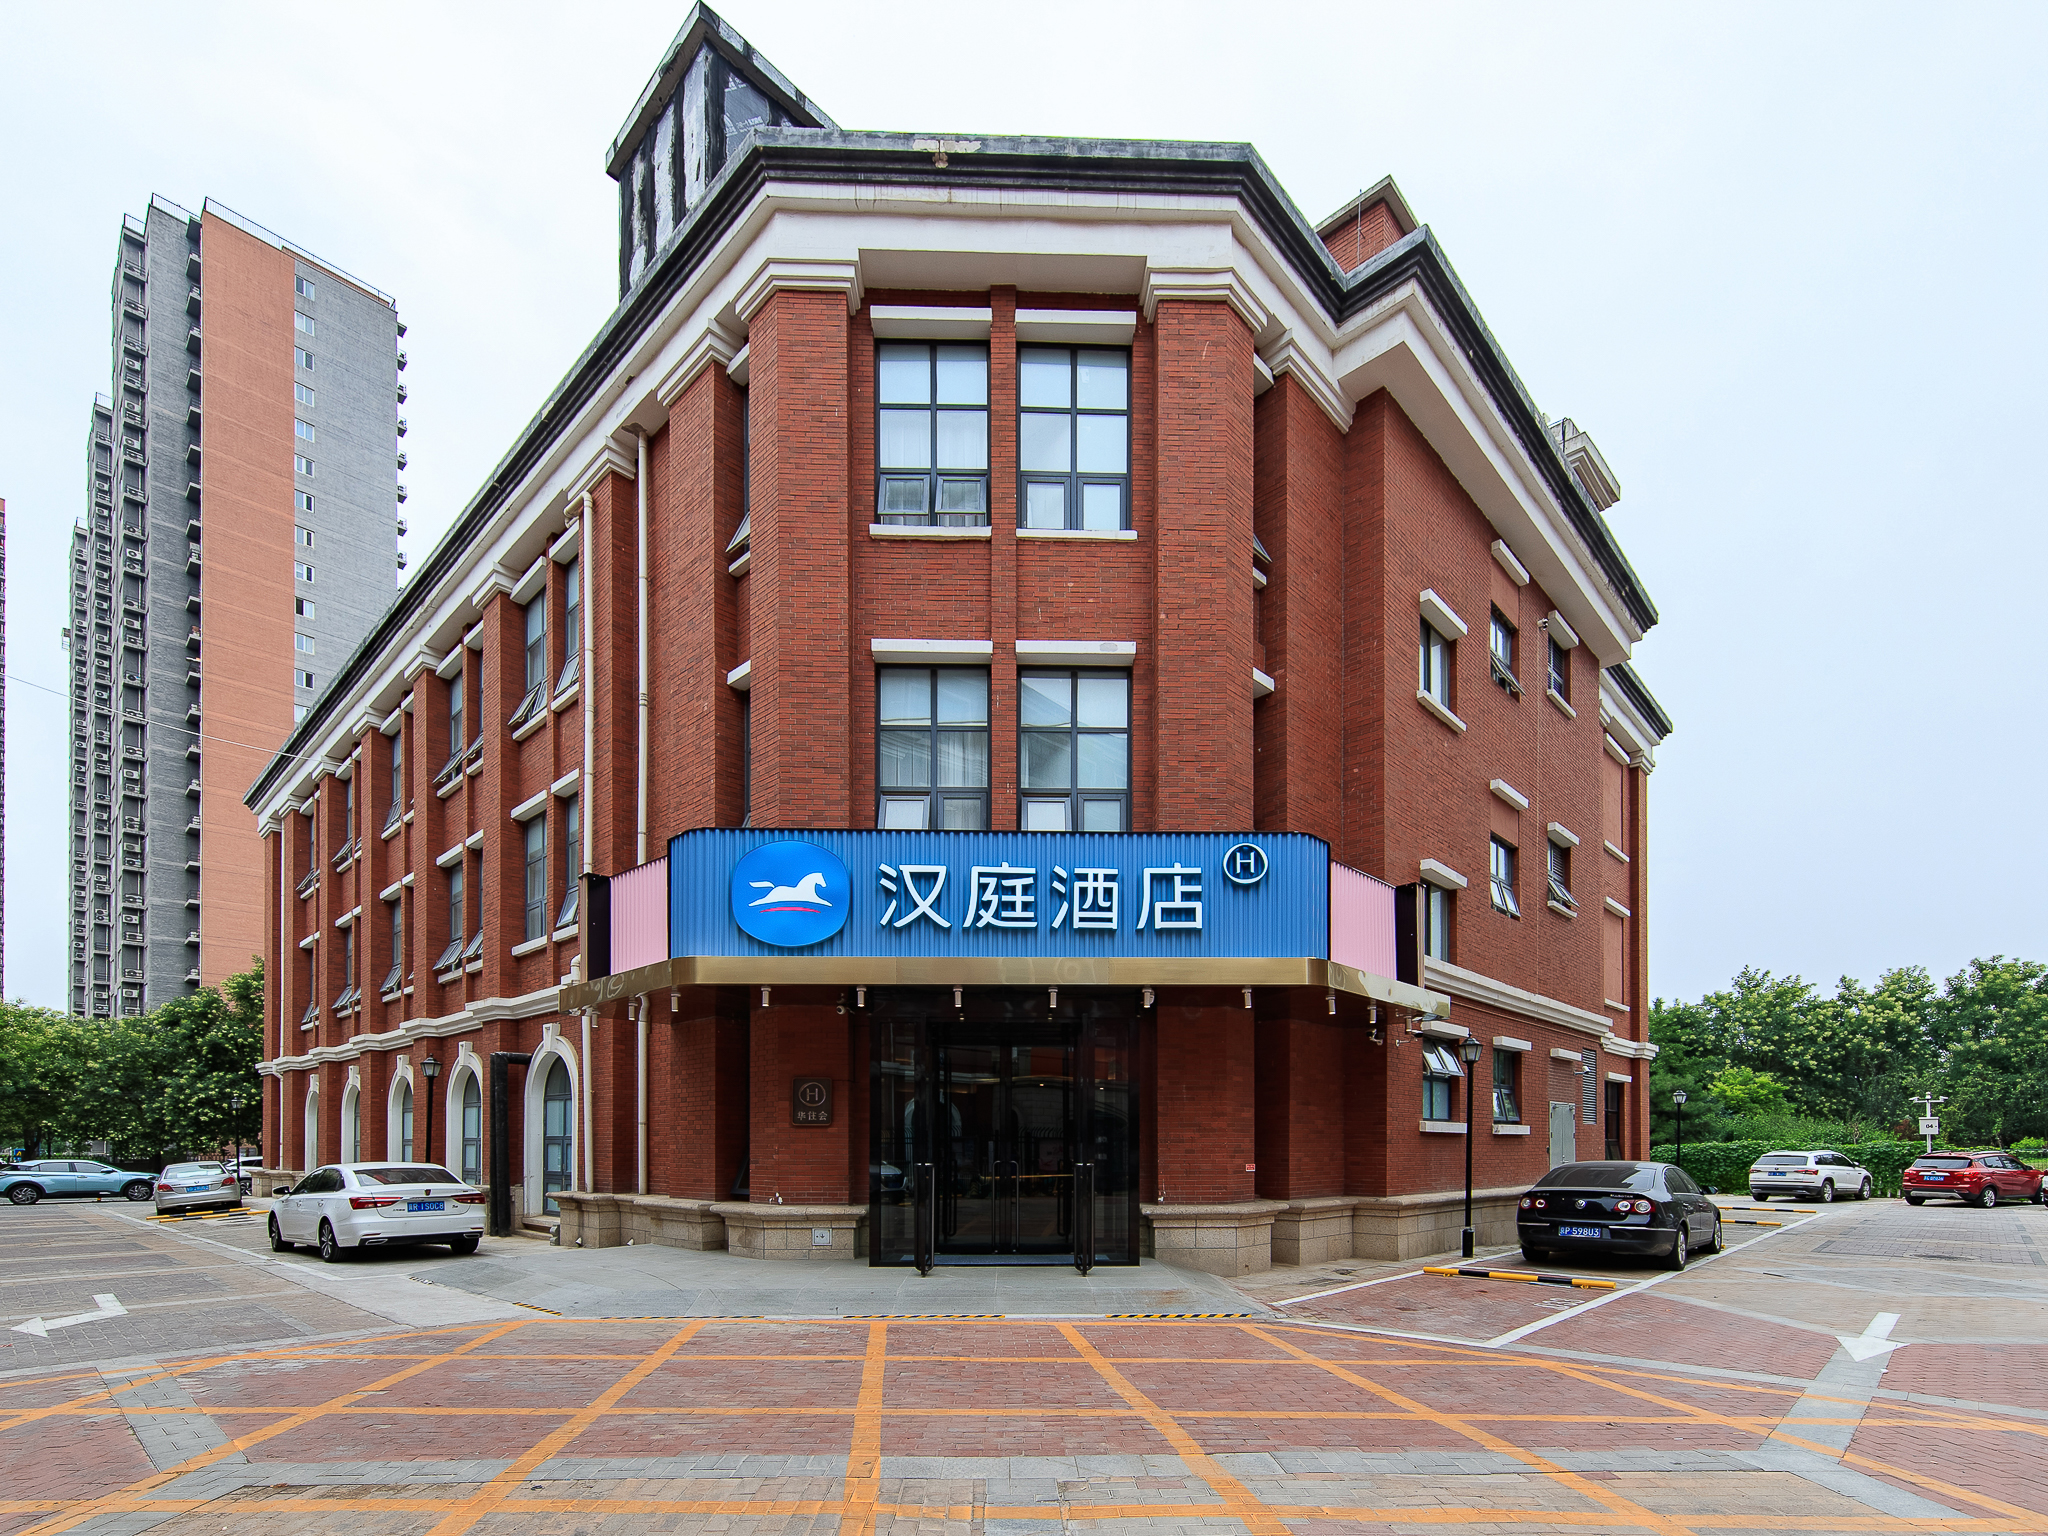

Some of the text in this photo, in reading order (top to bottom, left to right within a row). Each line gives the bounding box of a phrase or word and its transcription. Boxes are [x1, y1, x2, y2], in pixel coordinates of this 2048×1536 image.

[878, 861, 1203, 930] 汉庭酒店
[797, 1110, 828, 1121] 华住会
